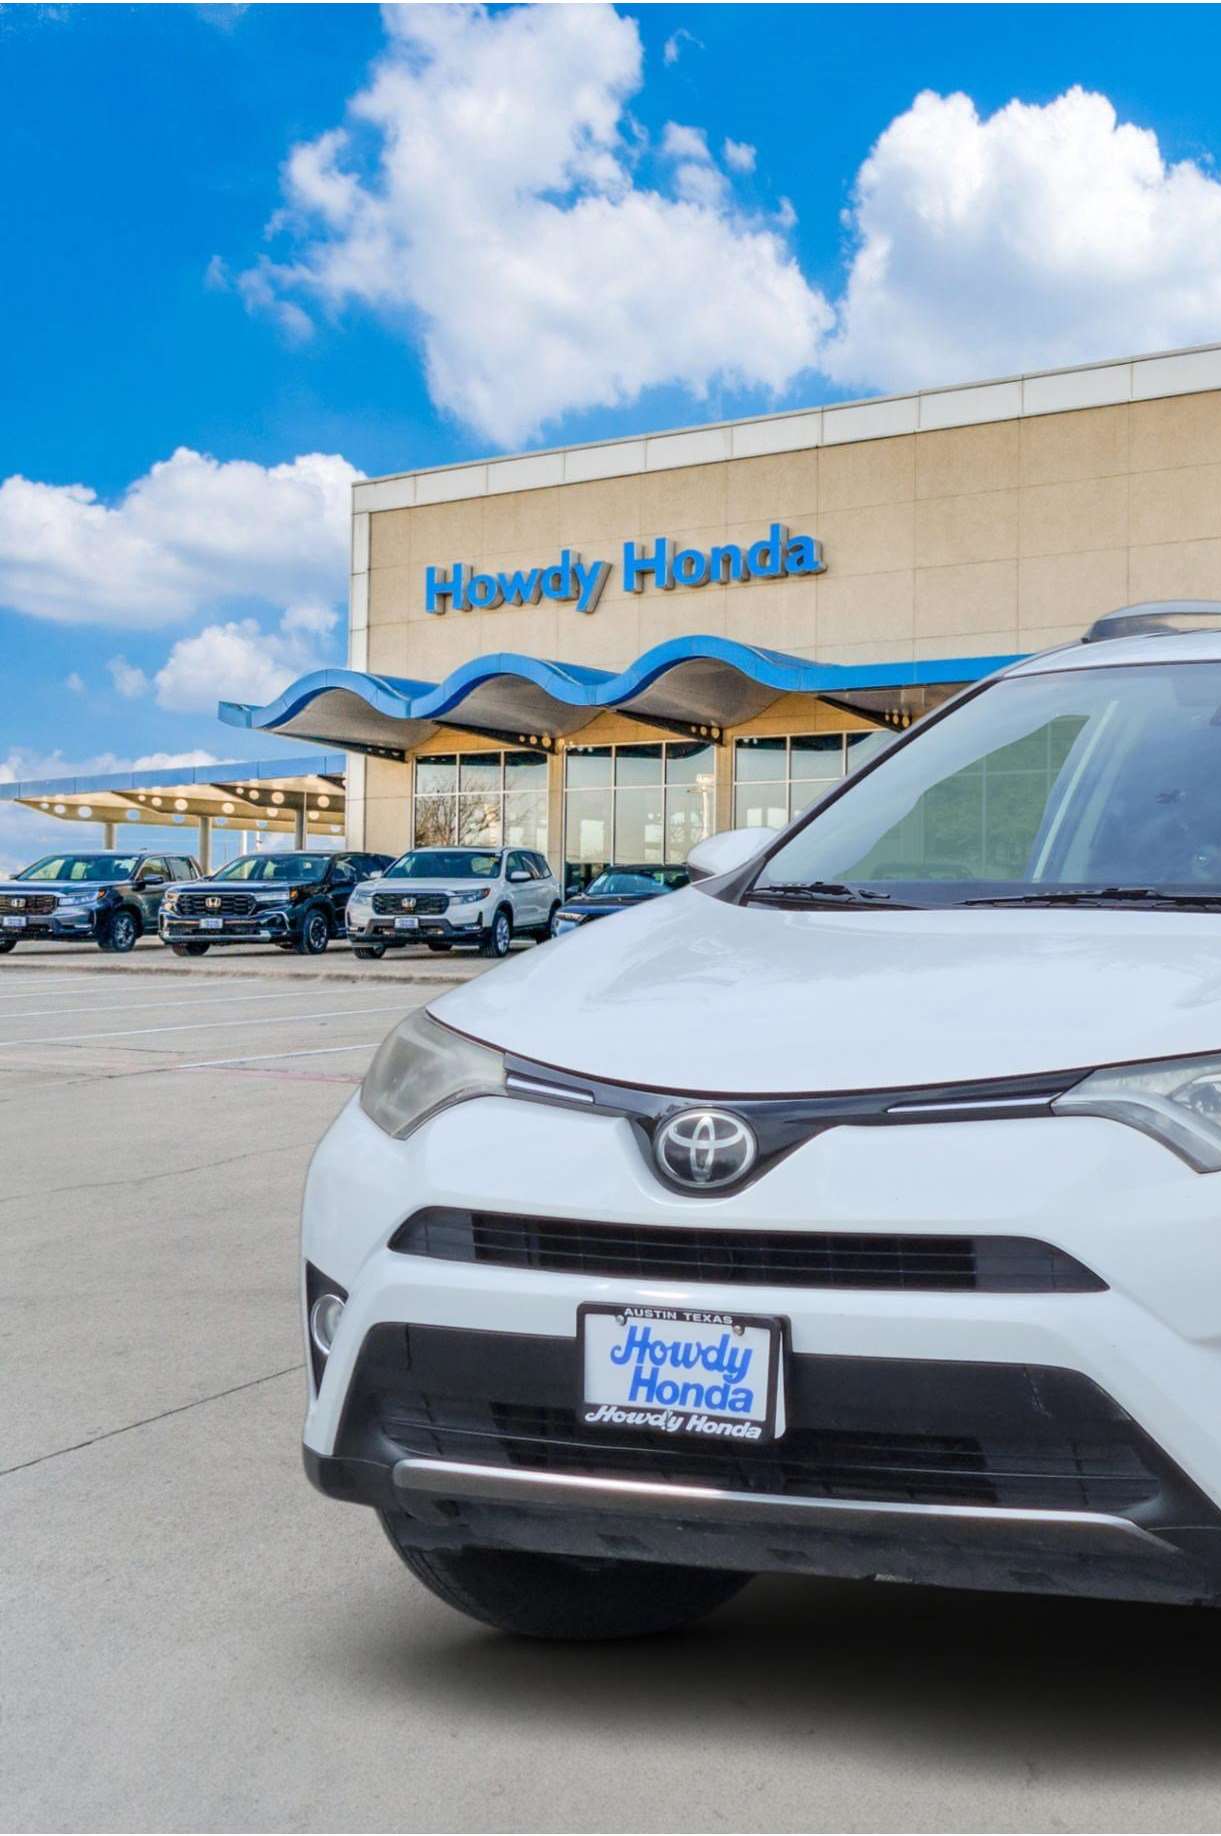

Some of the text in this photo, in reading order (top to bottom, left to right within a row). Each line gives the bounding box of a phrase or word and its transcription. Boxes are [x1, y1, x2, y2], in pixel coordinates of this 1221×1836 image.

[425, 522, 827, 615] Howdy Honda
[624, 1307, 734, 1324] AUSTIN TEXAS
[610, 1325, 753, 1384] Howdy
[628, 1366, 754, 1412] Honda
[585, 1405, 762, 1439] Howdy Honda
